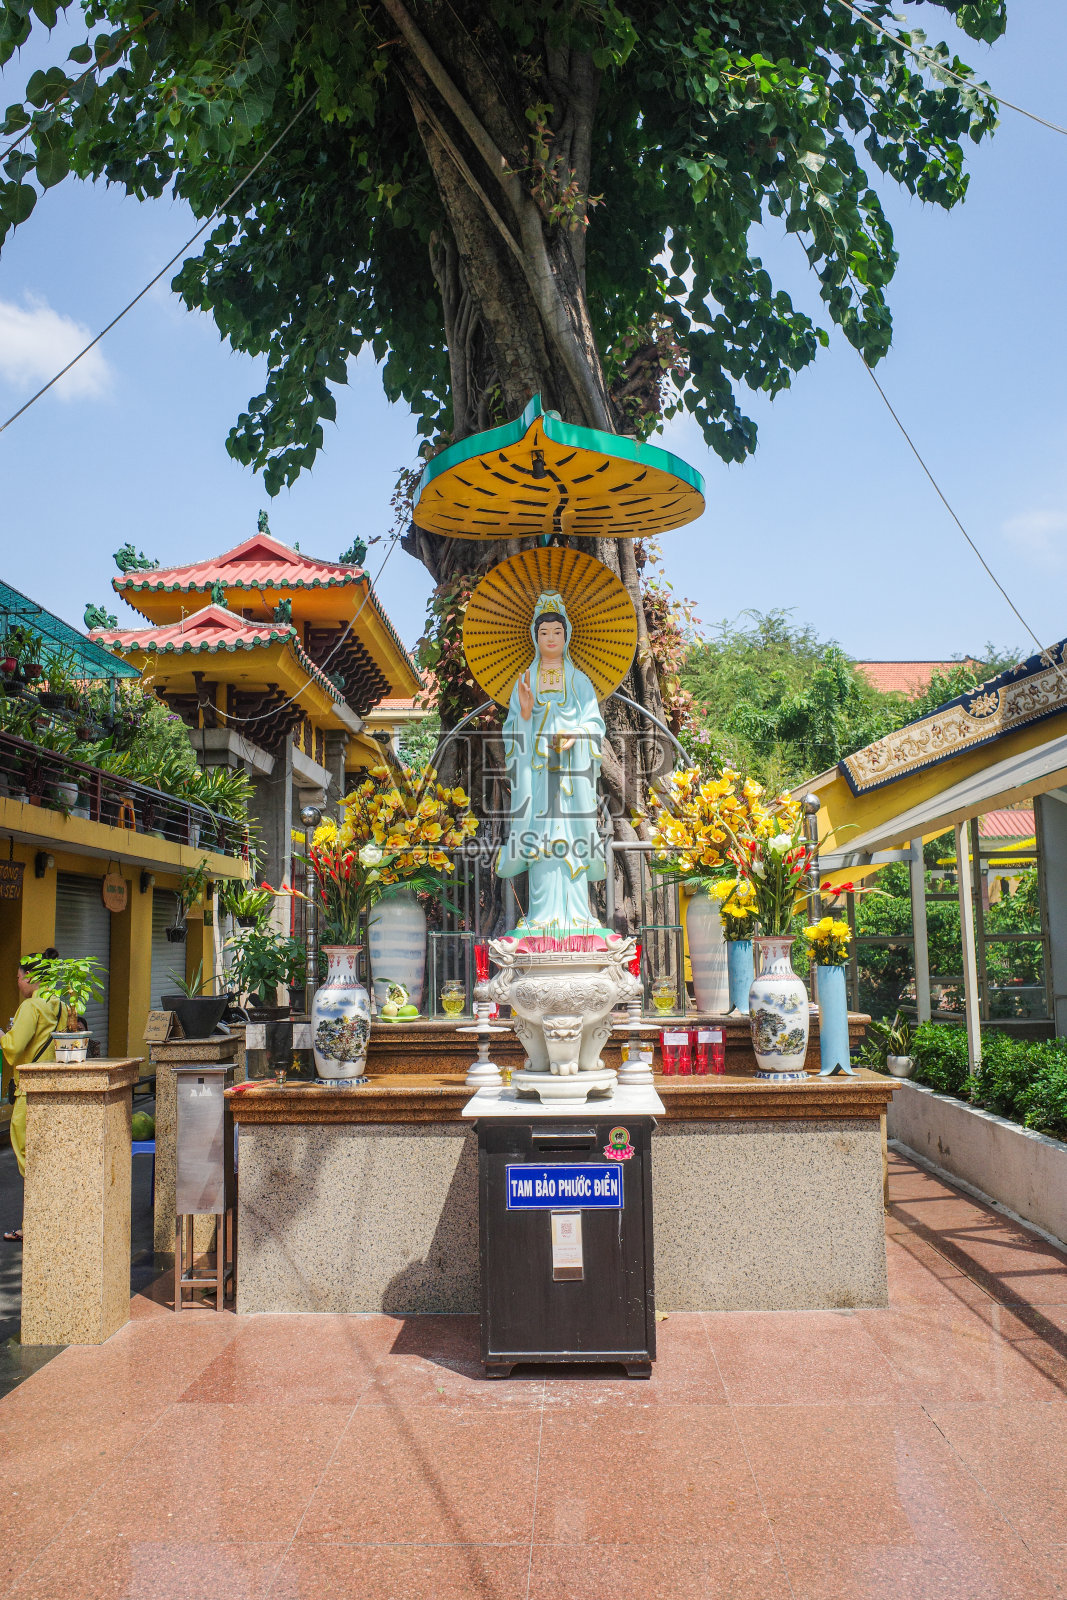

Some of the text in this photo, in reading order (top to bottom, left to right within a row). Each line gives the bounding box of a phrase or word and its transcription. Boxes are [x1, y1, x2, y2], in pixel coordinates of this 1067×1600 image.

[511, 1179, 533, 1197] TAM
[535, 1173, 556, 1197] BẢO
[558, 1174, 592, 1197] PHƯỚC
